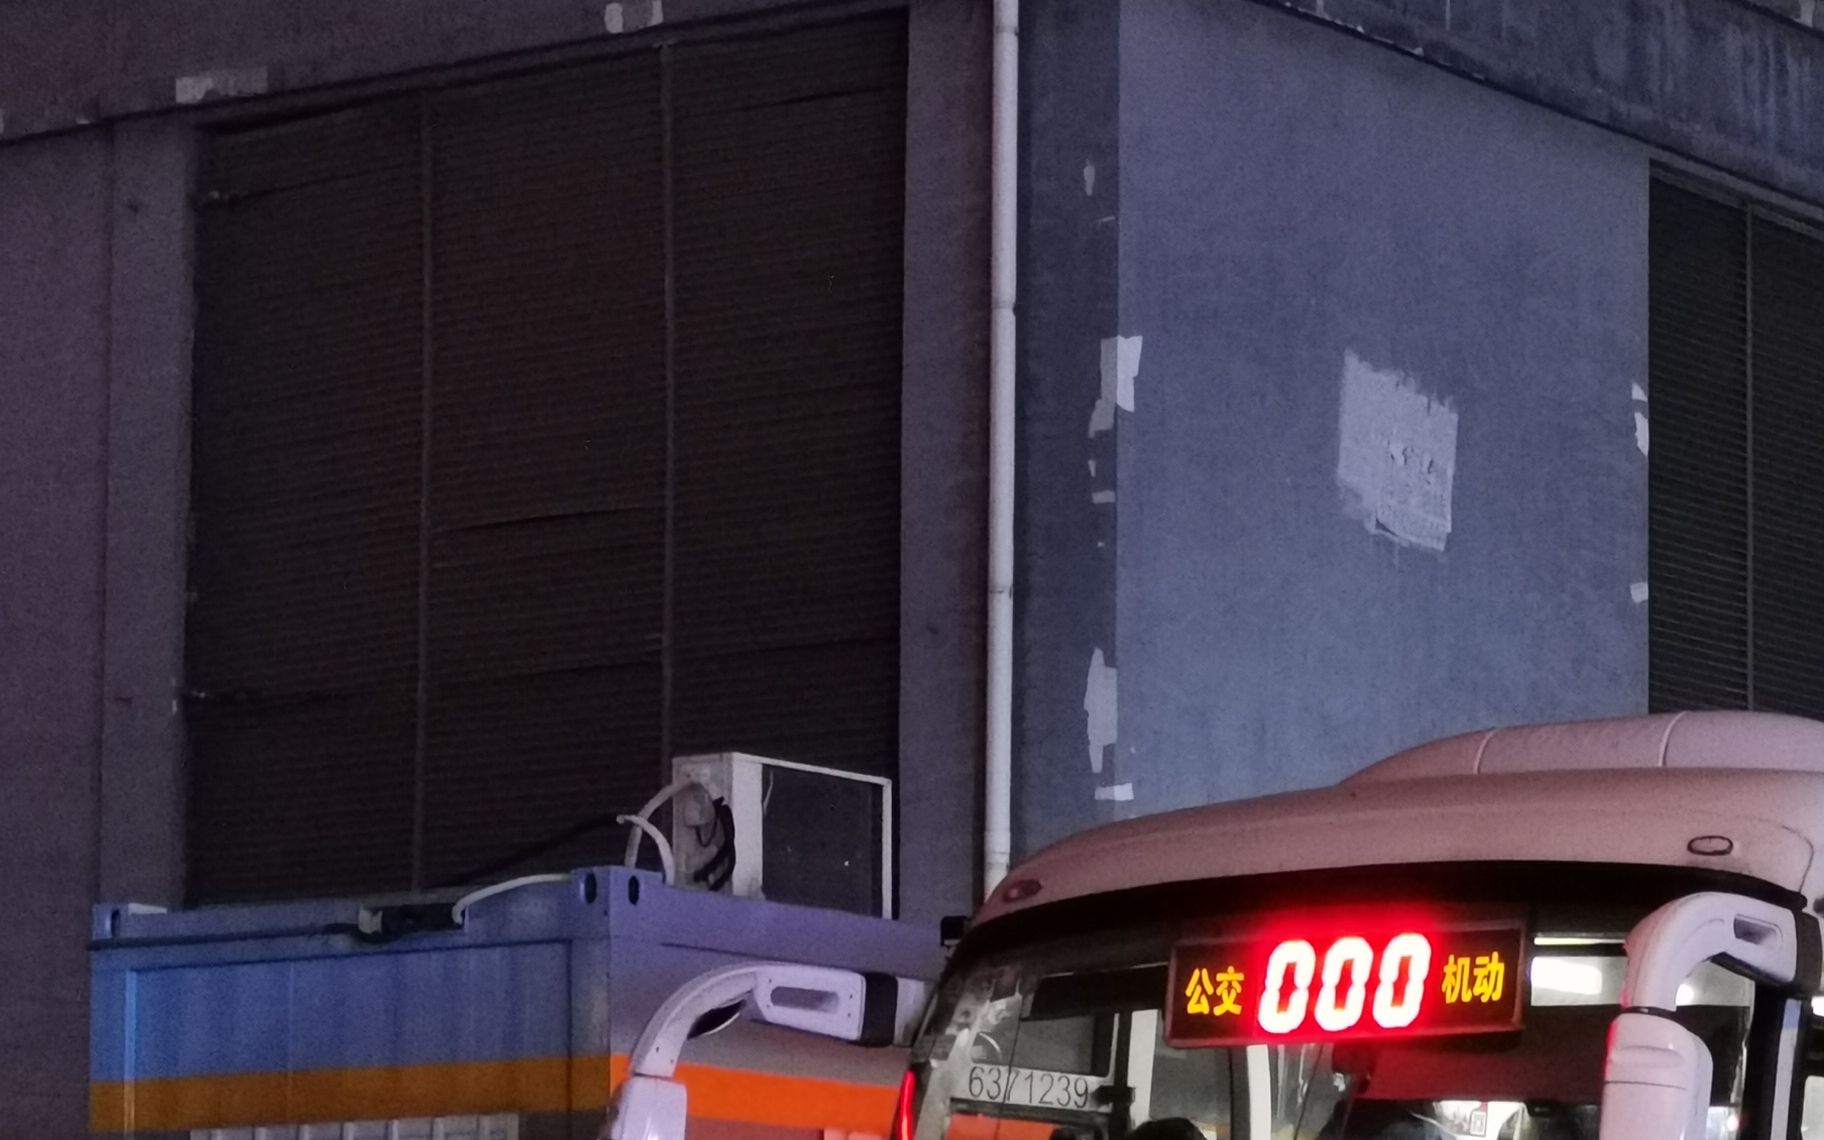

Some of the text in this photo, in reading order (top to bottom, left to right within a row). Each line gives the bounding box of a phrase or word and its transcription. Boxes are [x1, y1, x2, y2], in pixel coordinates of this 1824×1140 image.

[1185, 932, 1505, 1034] 公交 000 机动
[968, 1065, 1089, 1109] 6371239
